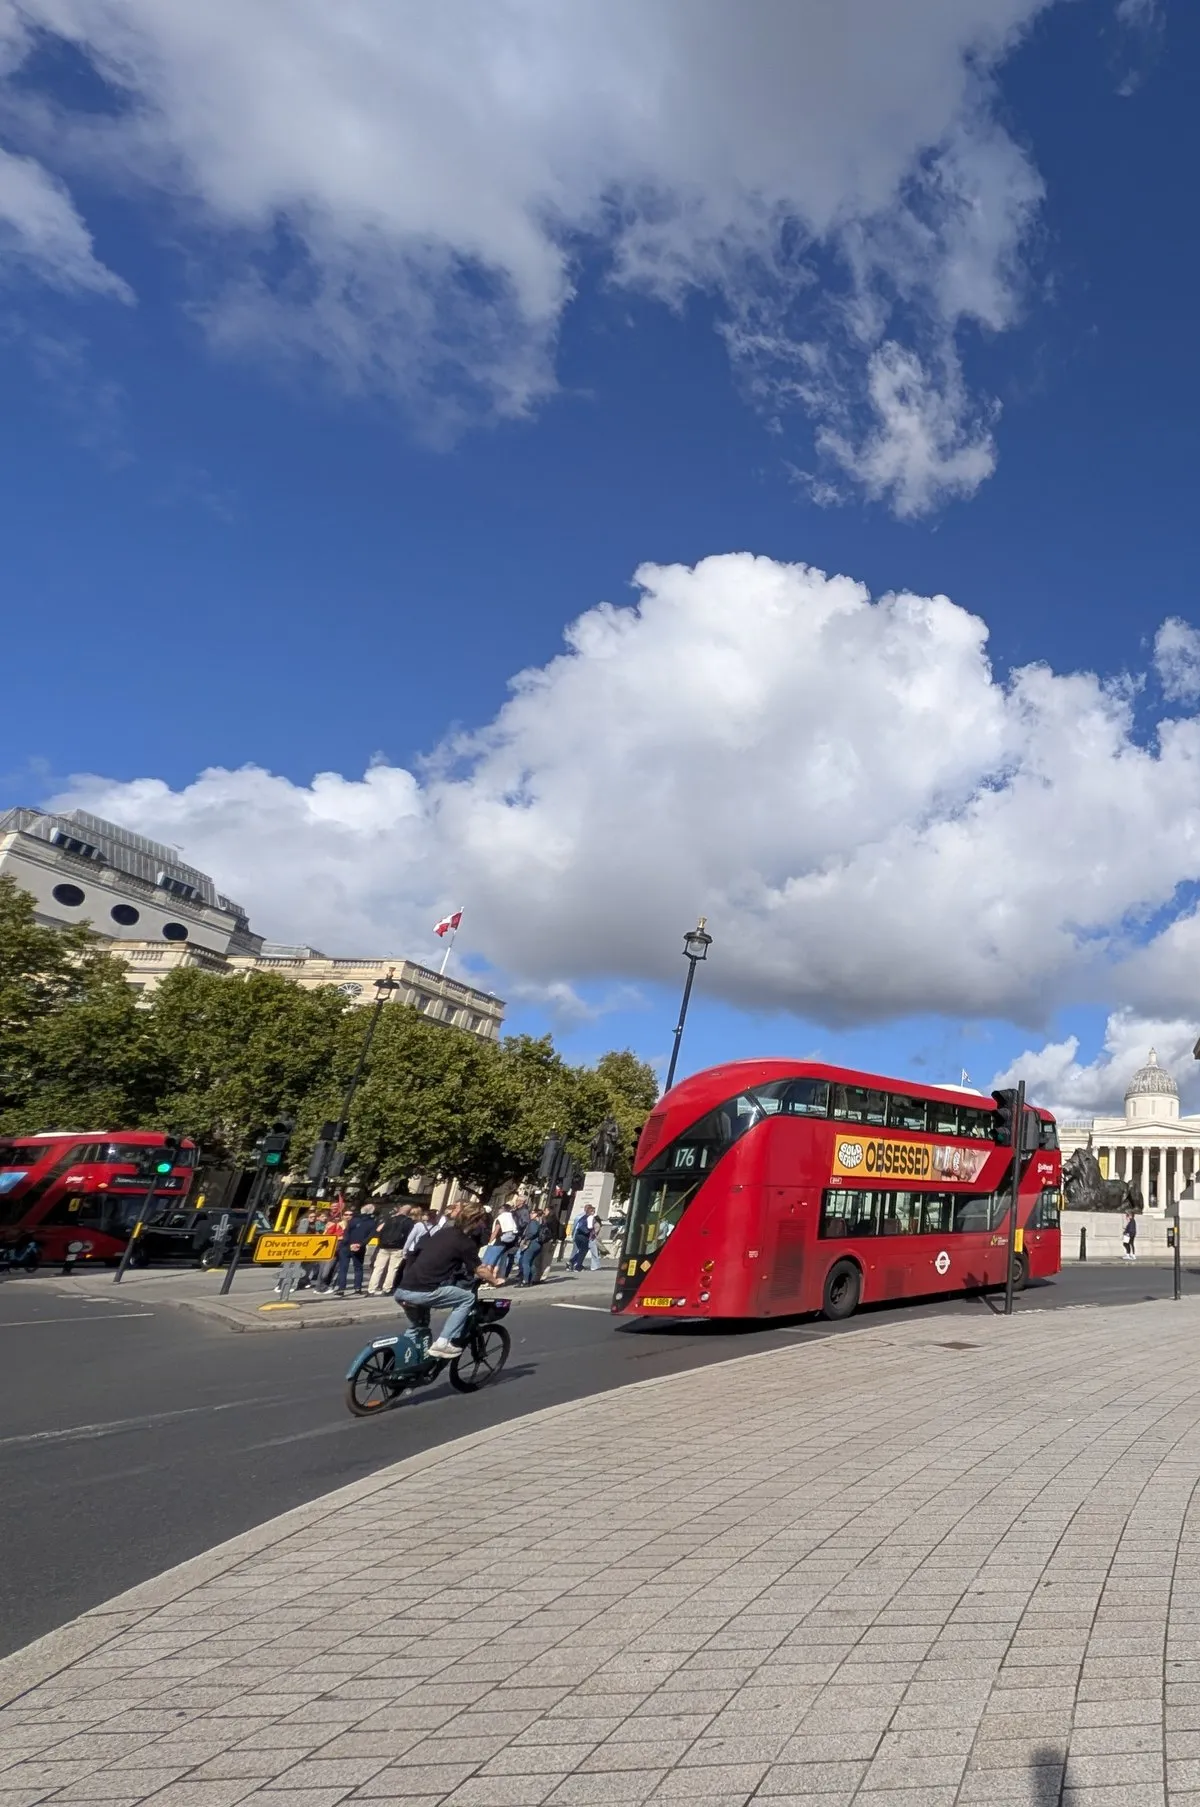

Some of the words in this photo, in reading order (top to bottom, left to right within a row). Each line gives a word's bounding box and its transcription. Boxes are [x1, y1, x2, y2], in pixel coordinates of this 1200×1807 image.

[675, 1148, 695, 1167] 176
[865, 1141, 930, 1176] OBSESSED
[264, 1240, 310, 1248] Diverted
[267, 1249, 301, 1257] traffic
